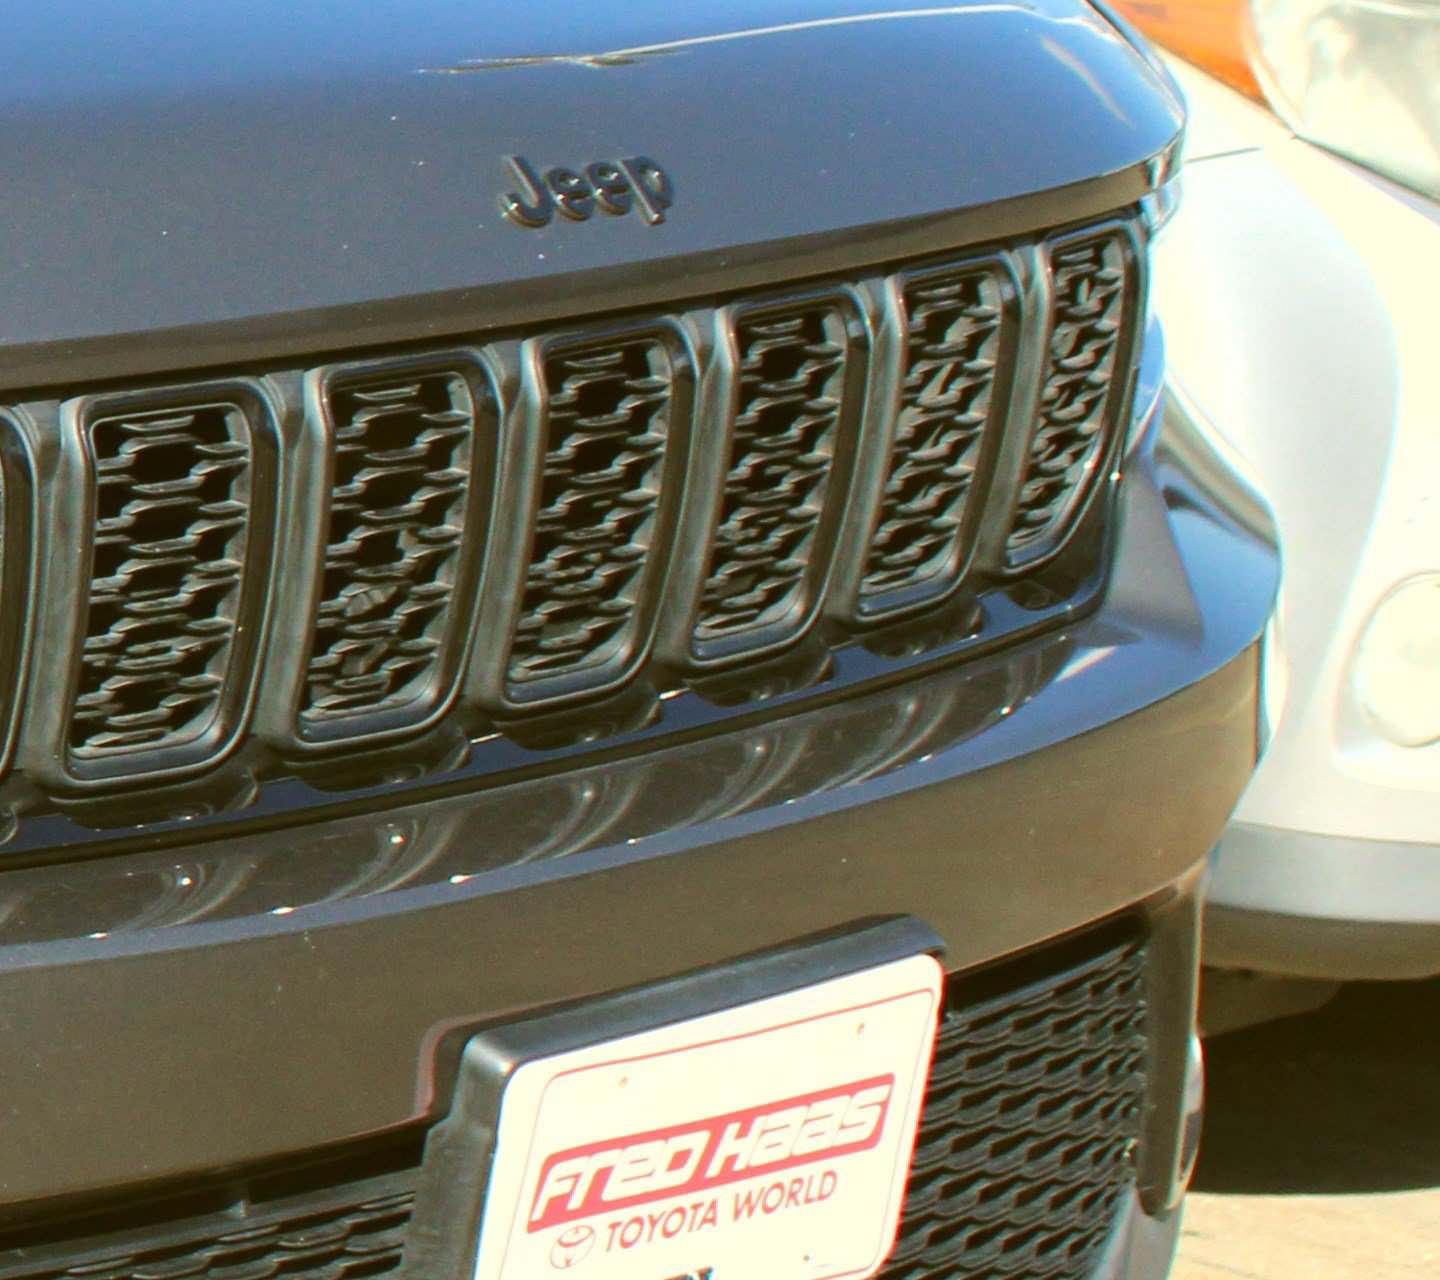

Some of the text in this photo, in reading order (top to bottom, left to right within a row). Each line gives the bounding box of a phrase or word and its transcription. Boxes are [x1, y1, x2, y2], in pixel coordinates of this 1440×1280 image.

[496, 155, 672, 227] Jeep
[604, 1169, 838, 1253] TOYOTA WORLD
